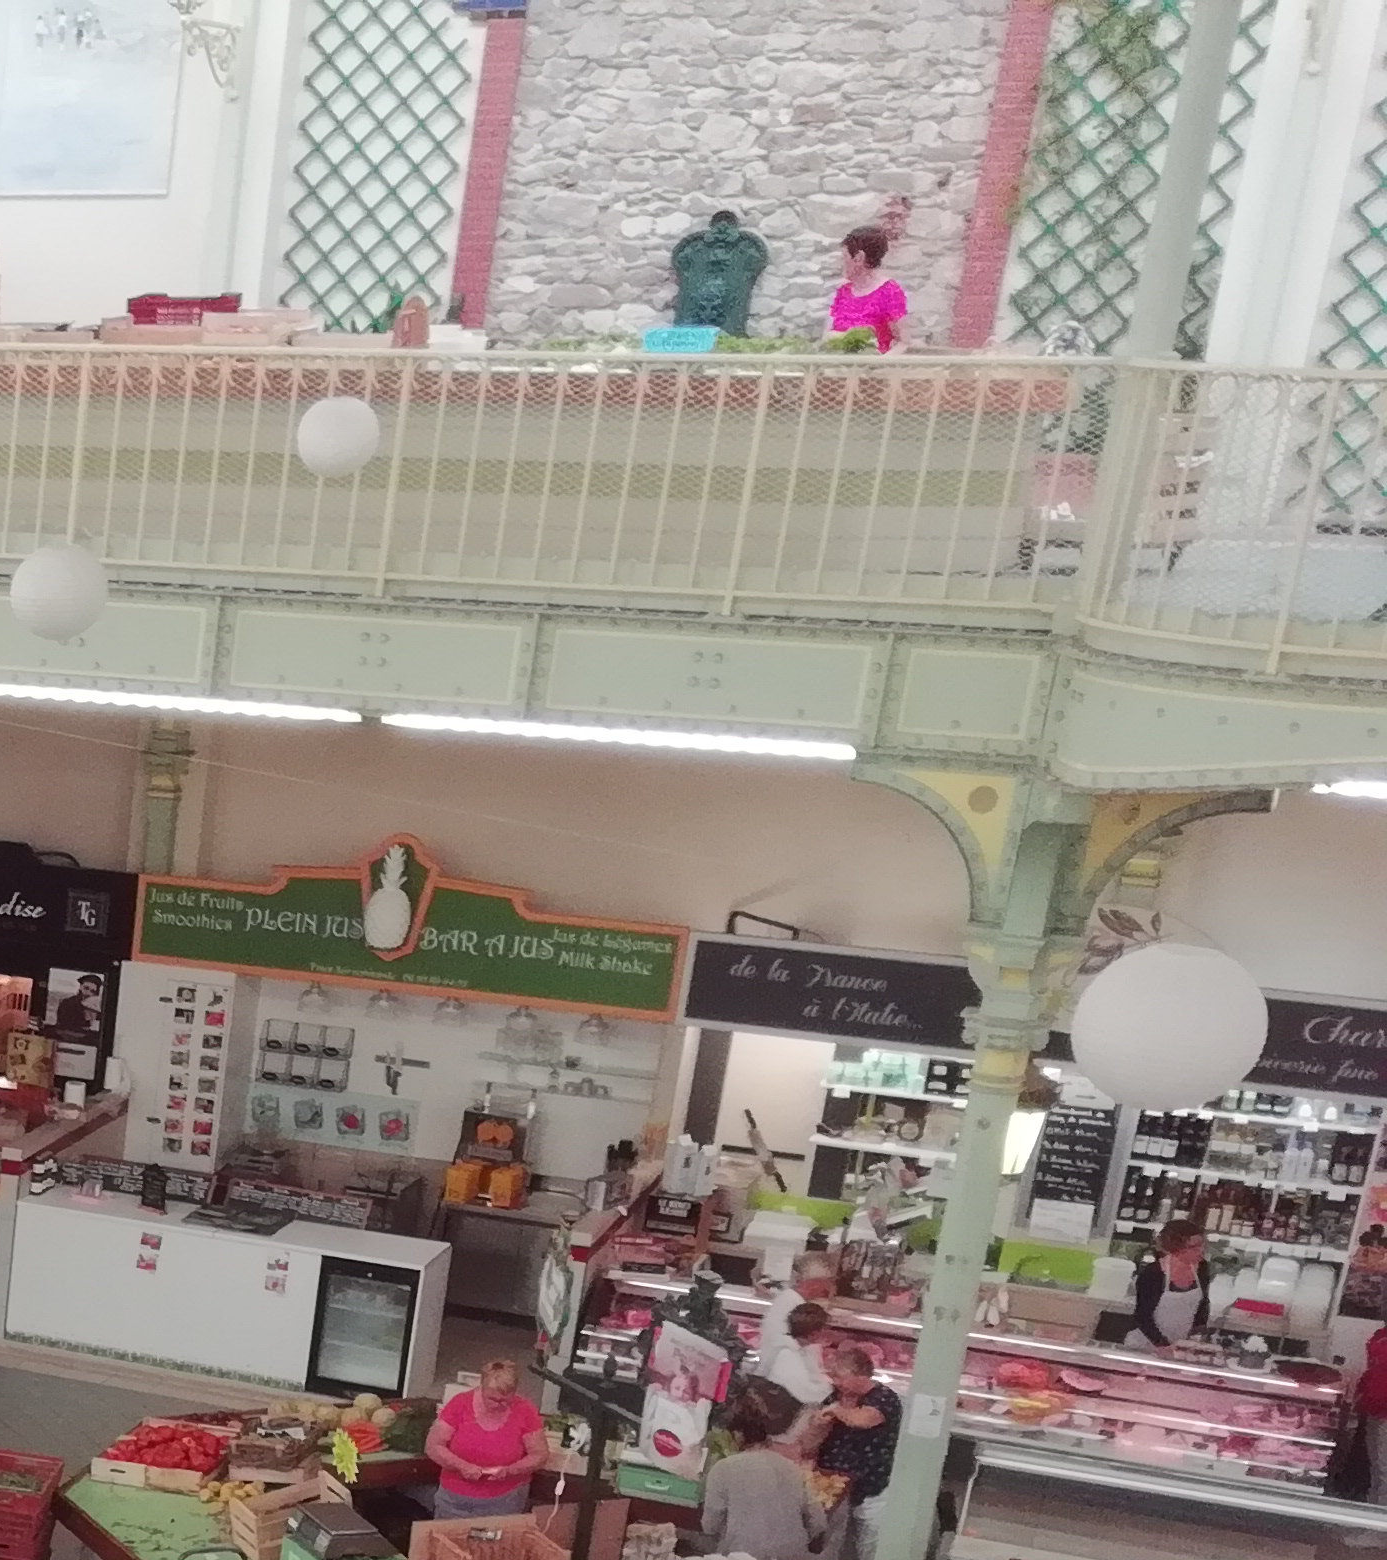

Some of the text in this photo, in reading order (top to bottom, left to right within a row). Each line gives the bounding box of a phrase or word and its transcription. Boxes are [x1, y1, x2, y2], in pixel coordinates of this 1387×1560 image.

[149, 886, 174, 905] Jus
[199, 891, 245, 912] Fruits
[151, 908, 234, 932] Smoothies
[242, 906, 366, 940] PLEIN JUS
[419, 926, 555, 961] BAR A JUS
[556, 949, 654, 977] Milk Shake
[729, 954, 889, 994] de la France
[801, 998, 822, 1018] à
